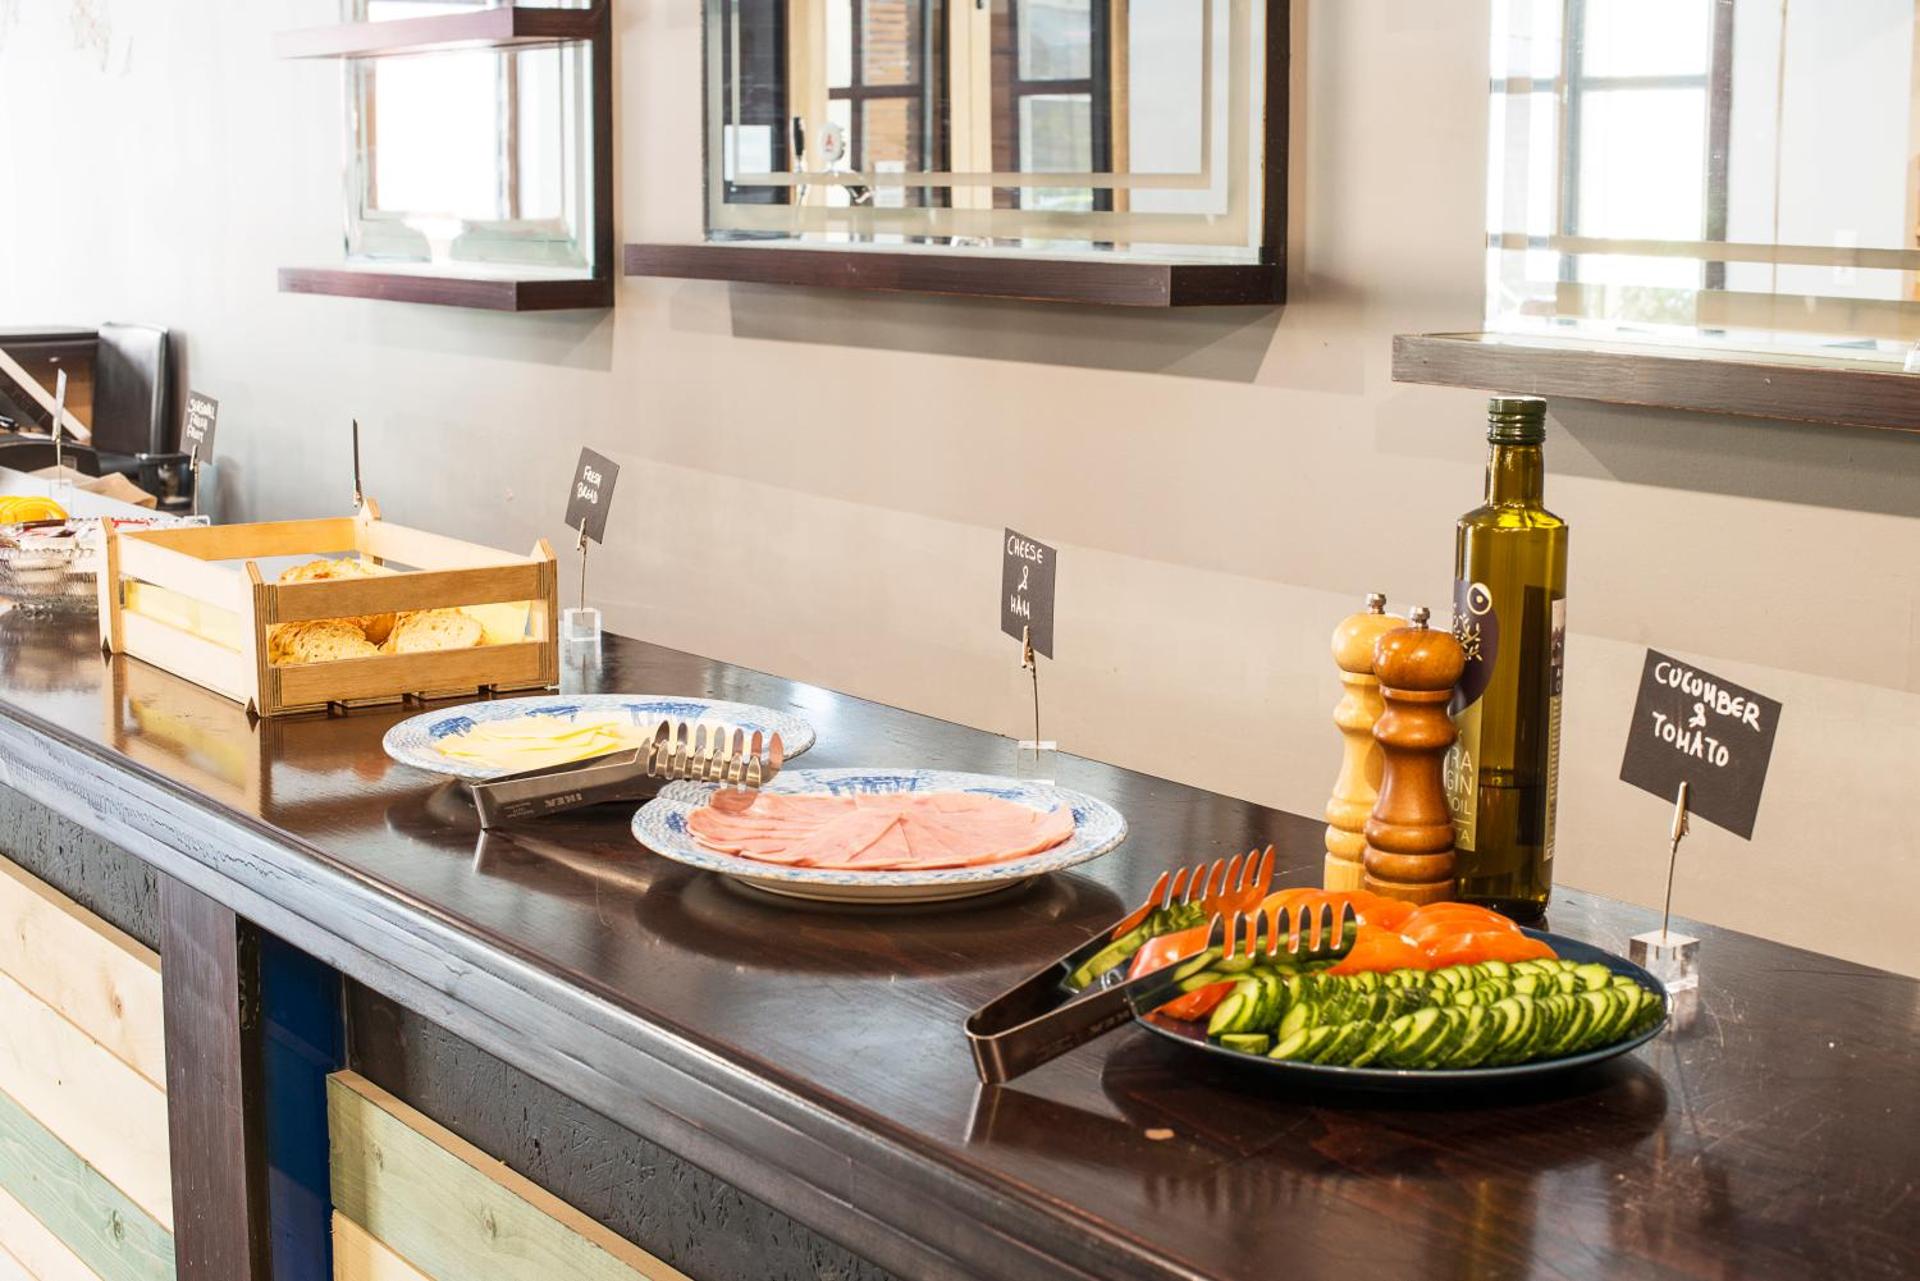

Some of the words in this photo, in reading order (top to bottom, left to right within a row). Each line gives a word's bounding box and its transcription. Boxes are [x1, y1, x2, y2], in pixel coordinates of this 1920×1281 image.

[1007, 535, 1043, 564] CHEESE
[1017, 565, 1029, 591] &
[1010, 594, 1030, 620] HAM
[1654, 662, 1761, 732] CUCUMBER
[1688, 702, 1706, 728] &
[1652, 711, 1729, 767] TOMATO
